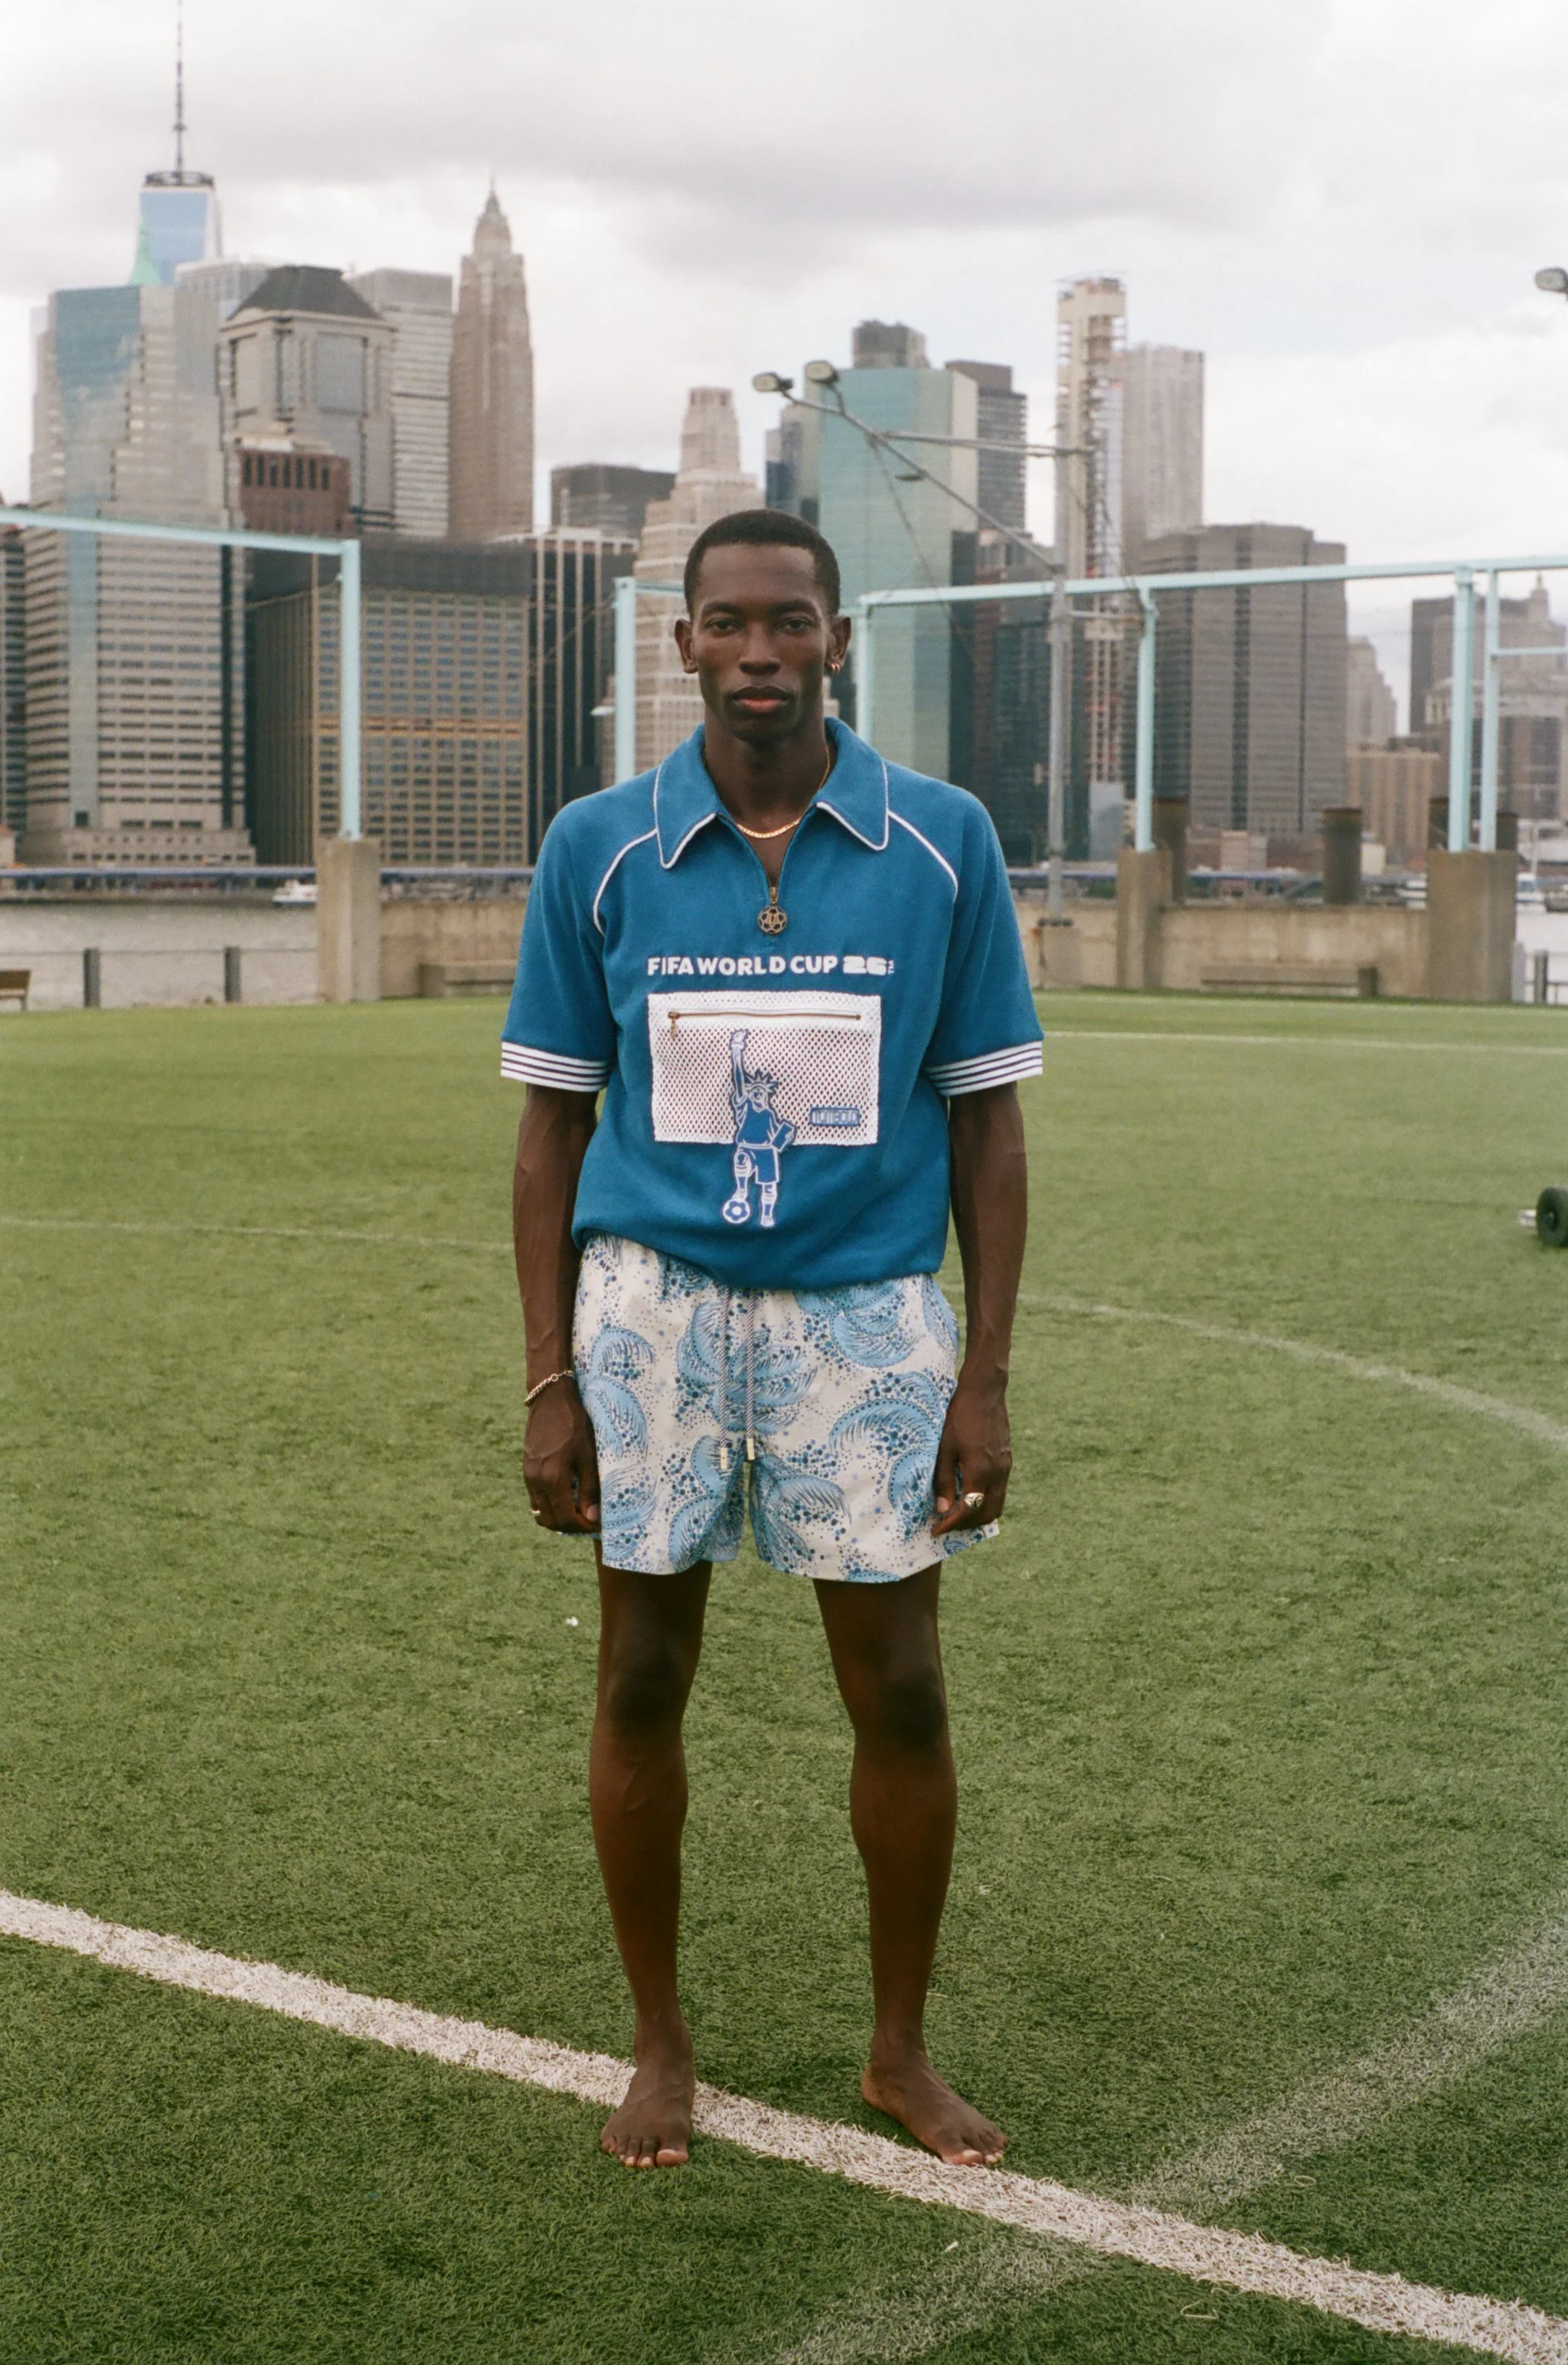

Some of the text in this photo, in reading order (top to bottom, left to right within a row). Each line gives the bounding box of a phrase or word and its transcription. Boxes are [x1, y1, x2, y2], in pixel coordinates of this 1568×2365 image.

[647, 956, 694, 975] FIFA
[697, 955, 786, 975] WORLD
[789, 955, 838, 974] CUP
[843, 955, 887, 976] 26
